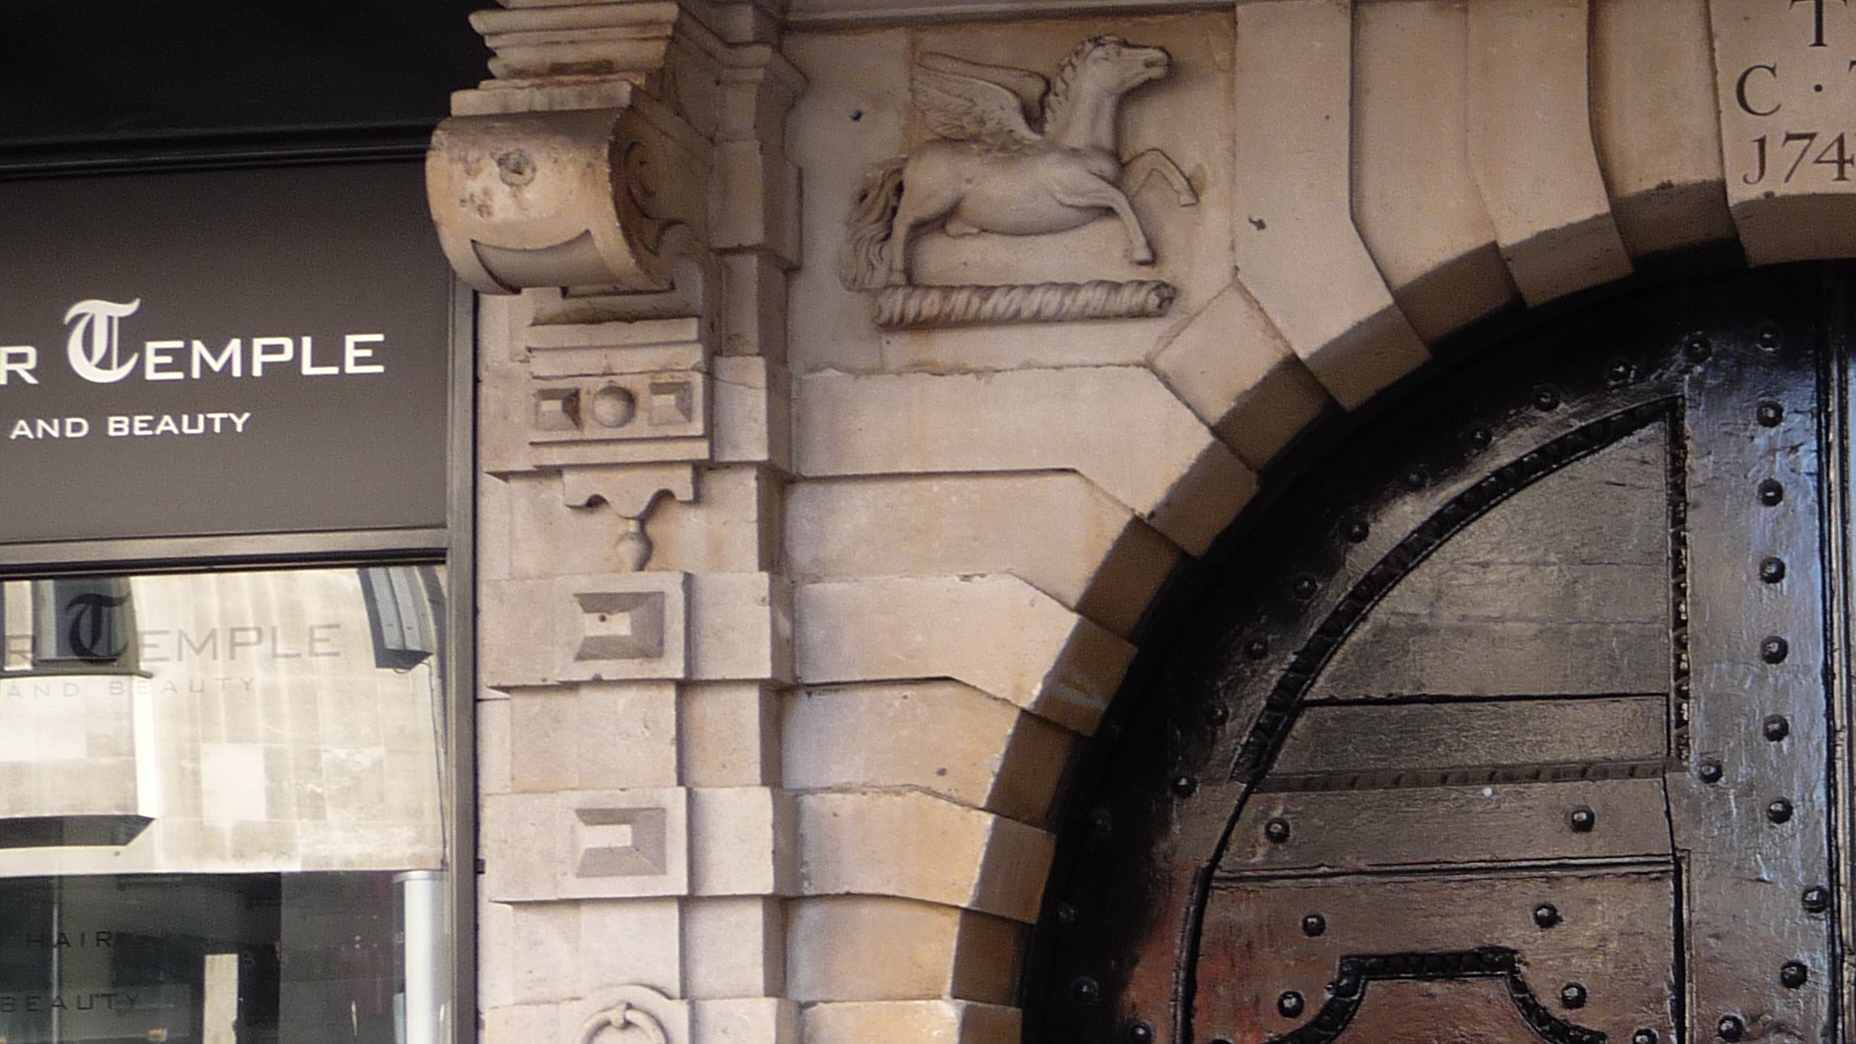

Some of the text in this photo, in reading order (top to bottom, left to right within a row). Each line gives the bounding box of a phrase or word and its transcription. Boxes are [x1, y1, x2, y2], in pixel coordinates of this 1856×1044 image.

[9, 412, 251, 440] AND BEAUTY
[7, 677, 255, 698] AND BEAUTY
[26, 931, 114, 949] HAIR
[0, 993, 140, 1012] BEAUTY
